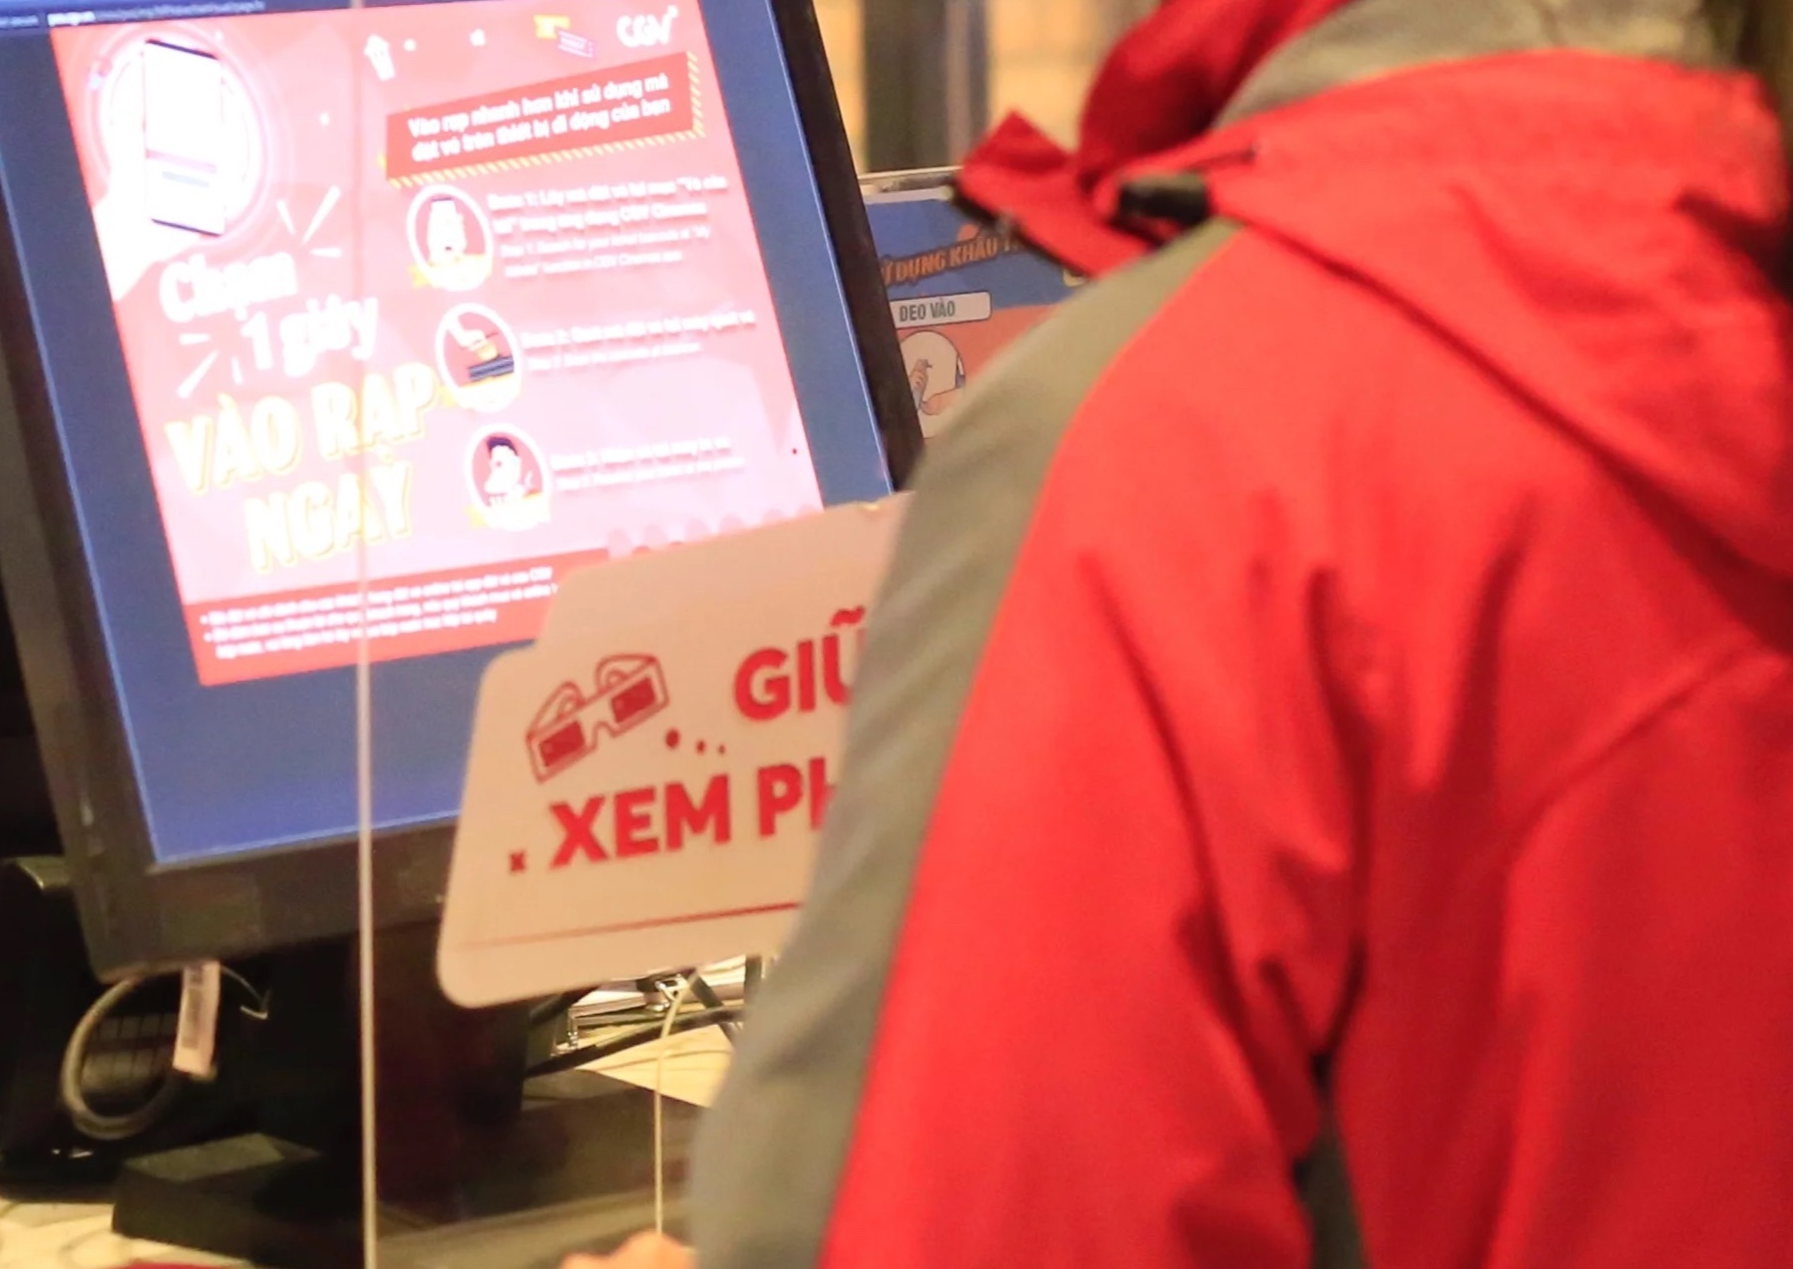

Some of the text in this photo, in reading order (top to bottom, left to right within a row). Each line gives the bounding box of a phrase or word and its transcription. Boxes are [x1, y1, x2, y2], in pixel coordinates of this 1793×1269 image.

[240, 311, 273, 370] 1
[164, 392, 303, 496] VÀO
[547, 773, 732, 871] XEM
